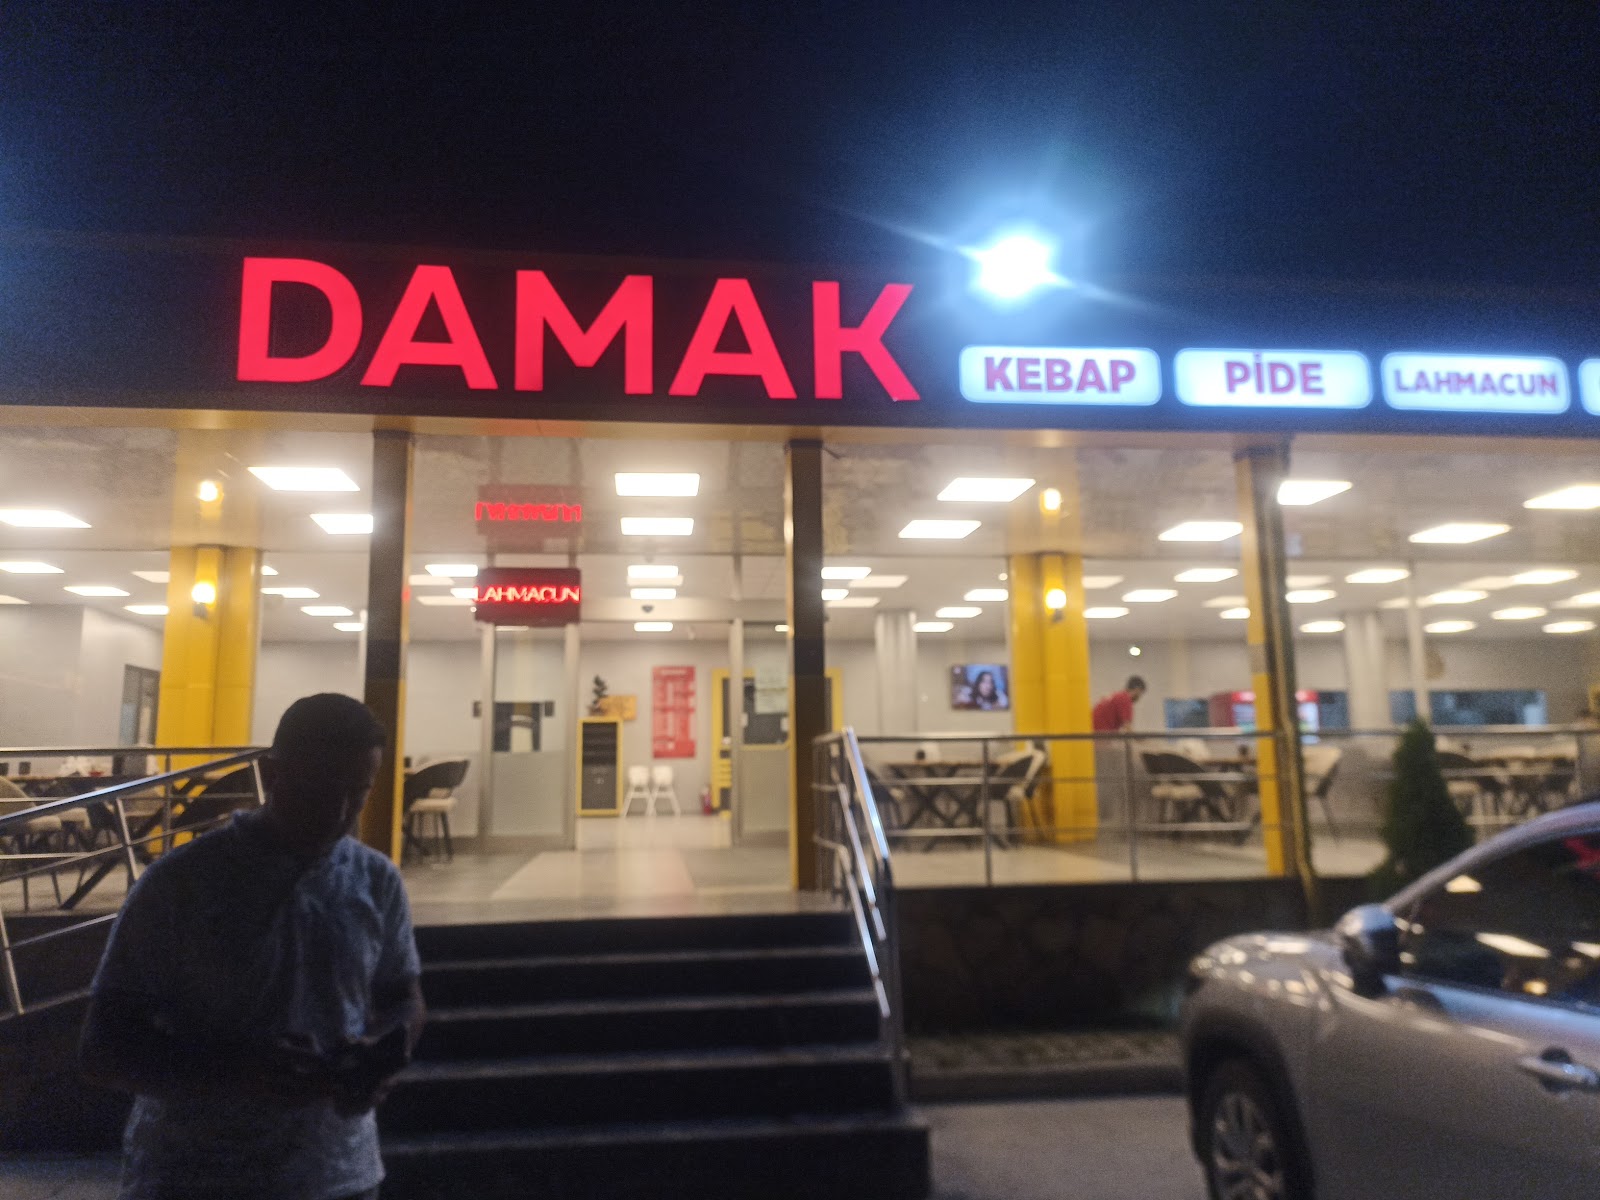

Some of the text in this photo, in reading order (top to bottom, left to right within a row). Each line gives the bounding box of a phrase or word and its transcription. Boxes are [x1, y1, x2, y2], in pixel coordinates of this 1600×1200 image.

[237, 257, 920, 401] DAMAK
[985, 357, 1136, 393] KEBAP
[1225, 352, 1325, 394] PİDE
[1394, 369, 1558, 396] LAHMACUN
[474, 585, 580, 603] LAHMACUN
